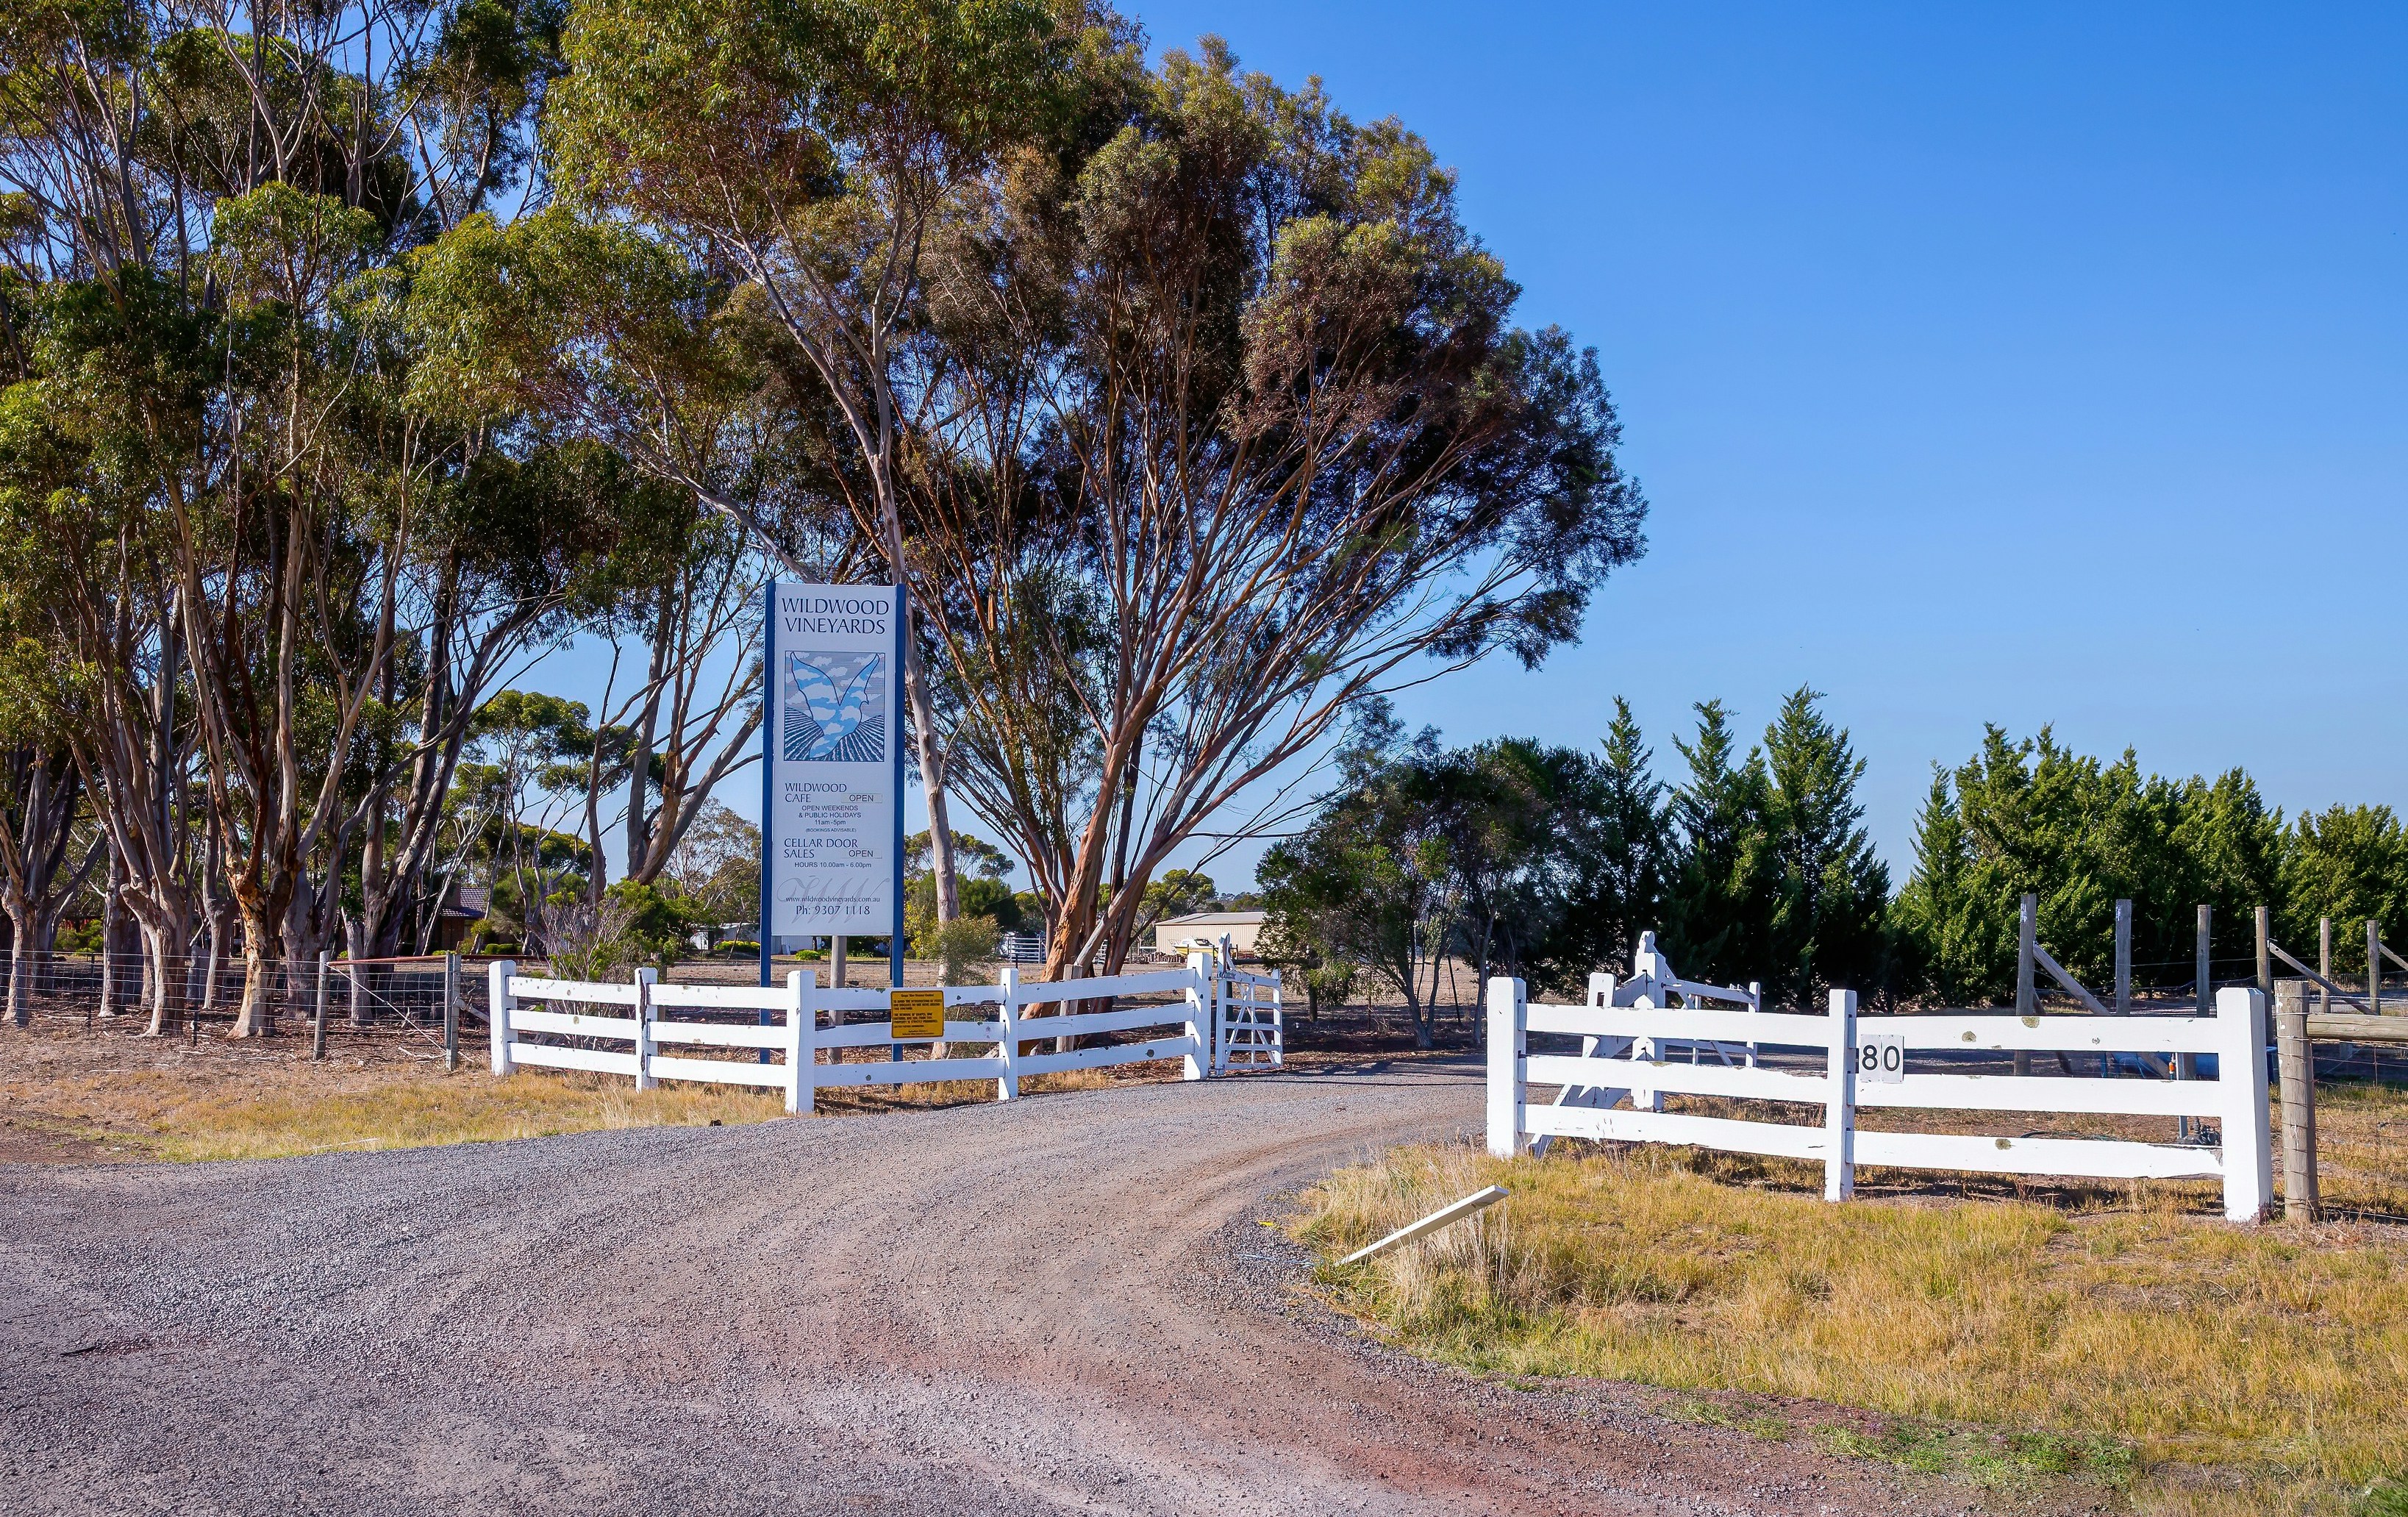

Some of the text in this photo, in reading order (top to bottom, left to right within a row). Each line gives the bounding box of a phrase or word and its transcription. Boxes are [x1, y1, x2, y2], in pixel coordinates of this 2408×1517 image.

[782, 598, 890, 615] WILDWOOD
[785, 617, 886, 635] VINEYARDS
[785, 783, 847, 793] WILDWOOD
[785, 793, 811, 803] CAFE
[784, 838, 858, 848] CELLAR DOOR
[784, 849, 815, 858] SALES
[786, 896, 880, 904] www.wildwoodvineyards.com.au
[796, 906, 871, 915] Ph: 9307 1118
[1862, 1045, 1900, 1071] 80
